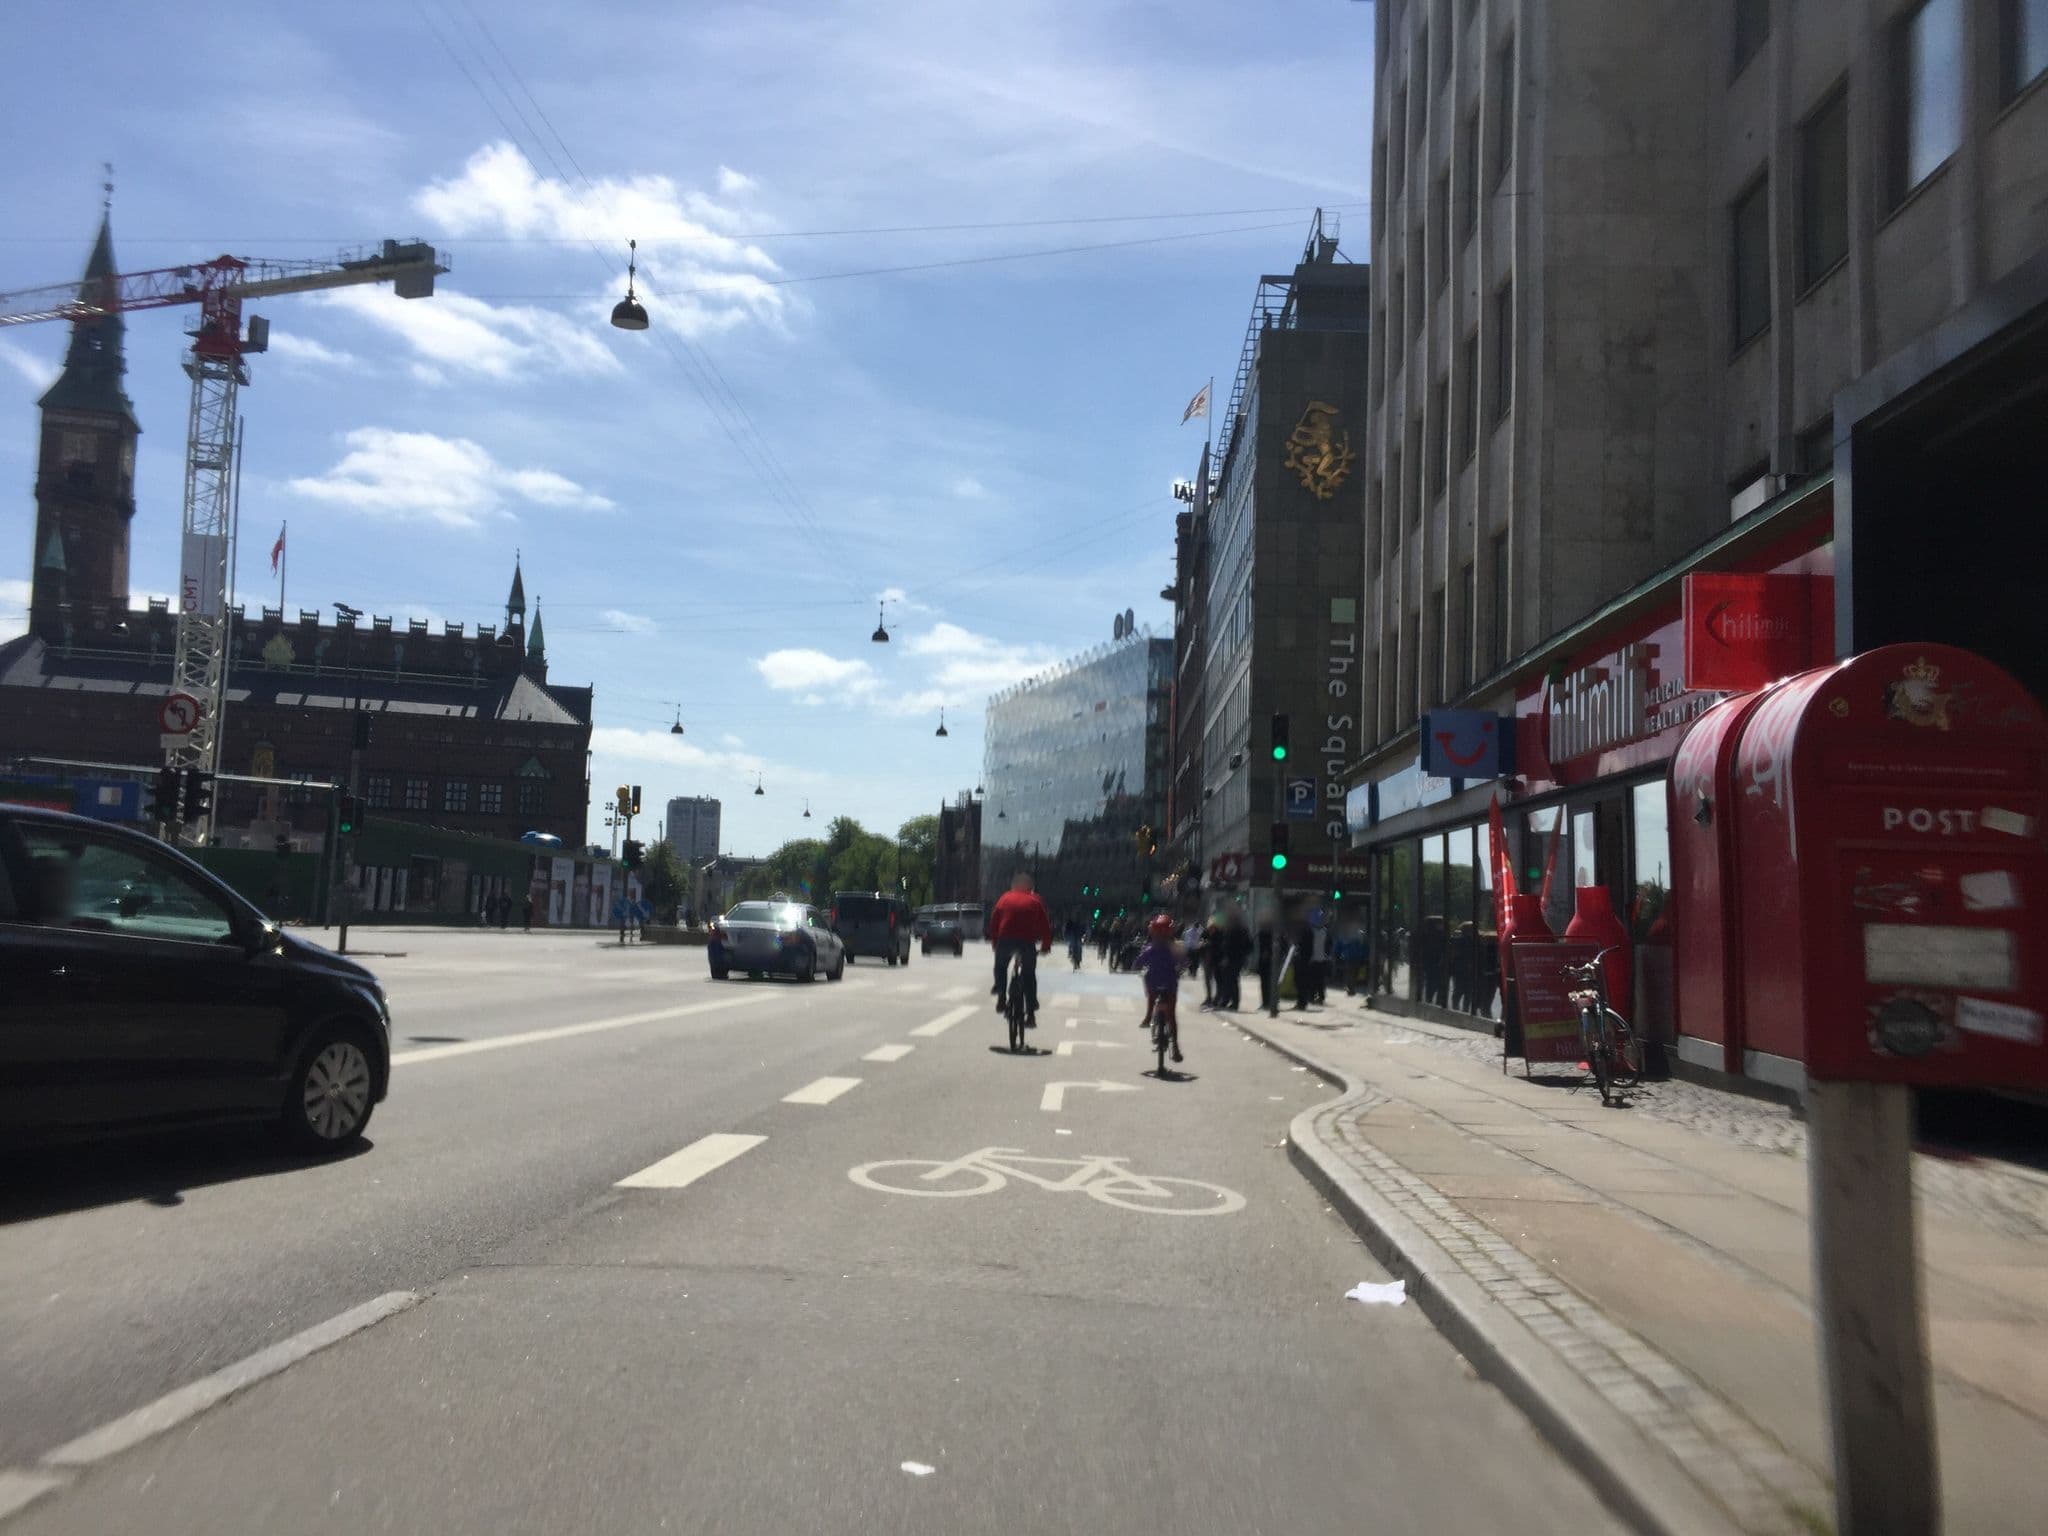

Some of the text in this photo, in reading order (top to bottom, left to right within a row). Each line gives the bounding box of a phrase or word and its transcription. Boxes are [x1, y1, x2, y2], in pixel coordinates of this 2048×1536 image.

[183, 575, 197, 611] CMT
[1329, 633, 1354, 697] The
[1643, 677, 1686, 705] DELICIO
[1321, 715, 1352, 839] Square
[1884, 808, 1974, 834] POST
